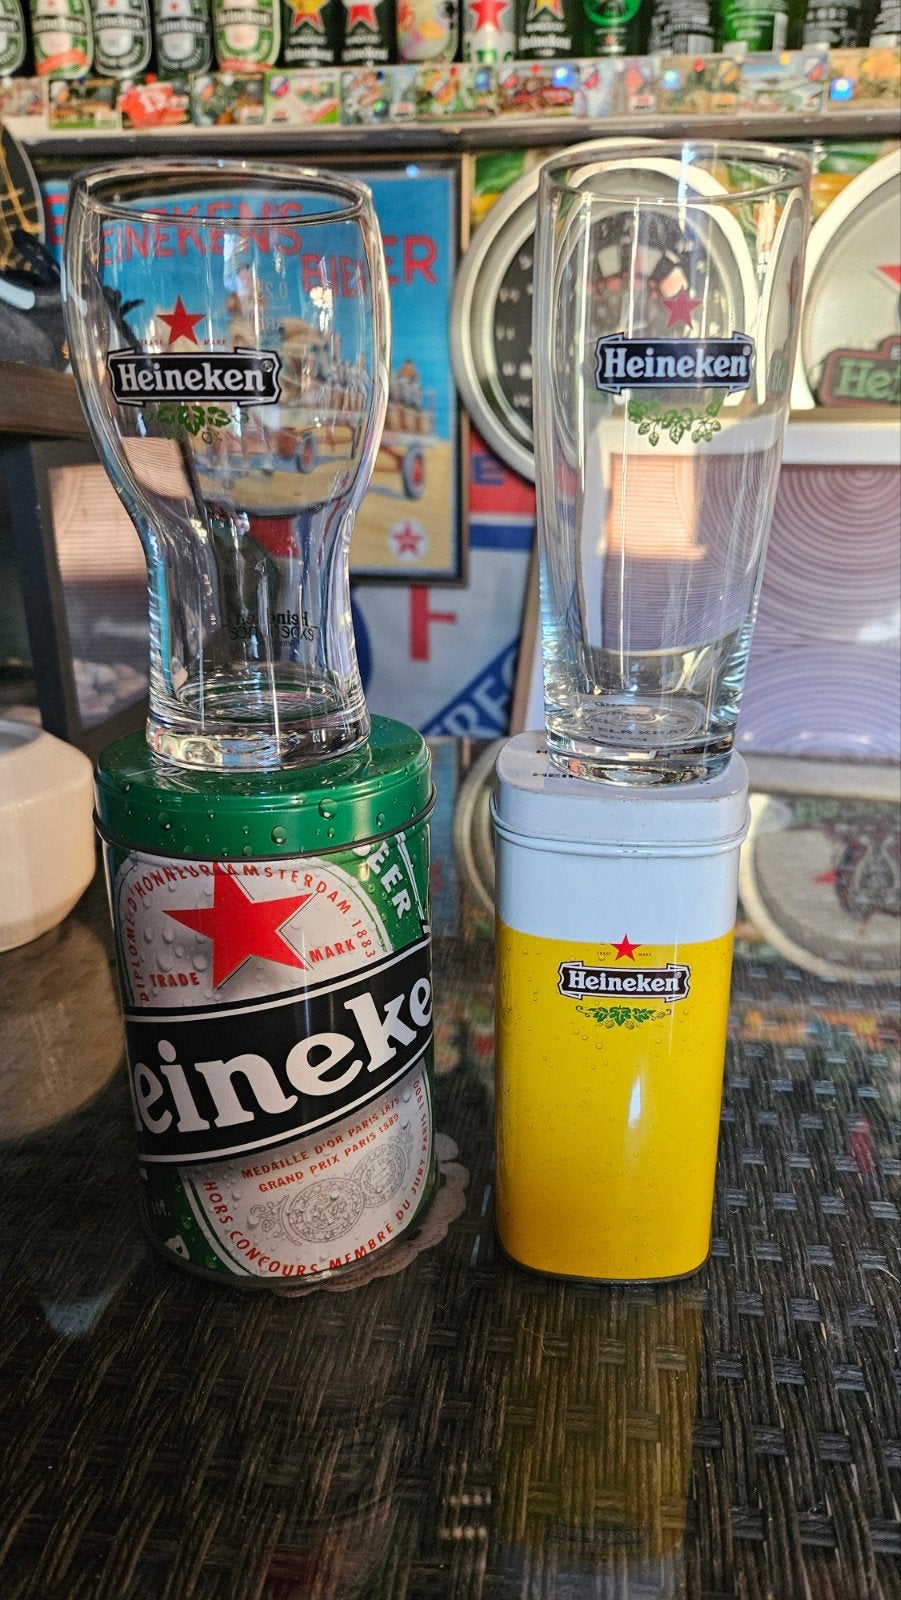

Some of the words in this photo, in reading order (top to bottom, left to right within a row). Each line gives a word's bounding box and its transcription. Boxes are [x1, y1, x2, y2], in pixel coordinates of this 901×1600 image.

[117, 362, 266, 392] Heineken
[603, 346, 748, 379] Heineken
[226, 863, 351, 914] AMSTERDAM
[351, 919, 375, 958] 1883
[149, 972, 201, 988] TRADE
[309, 938, 356, 963] MARK
[567, 971, 680, 993] Heineken
[241, 1150, 310, 1179] MEDAILLE
[316, 1135, 345, 1155] D'OR
[348, 1112, 379, 1138] PARIS
[381, 1097, 400, 1117] 1875
[258, 1171, 304, 1193] GRAND
[309, 1154, 340, 1175] PRIX
[344, 1132, 377, 1157] PARIS
[378, 1113, 399, 1134] 1889
[203, 1181, 233, 1224] HORS
[229, 1230, 318, 1277] CONCOURS
[329, 1222, 394, 1269] MEMBRE
[395, 1199, 411, 1221] DU
[411, 1159, 426, 1195] JURY
